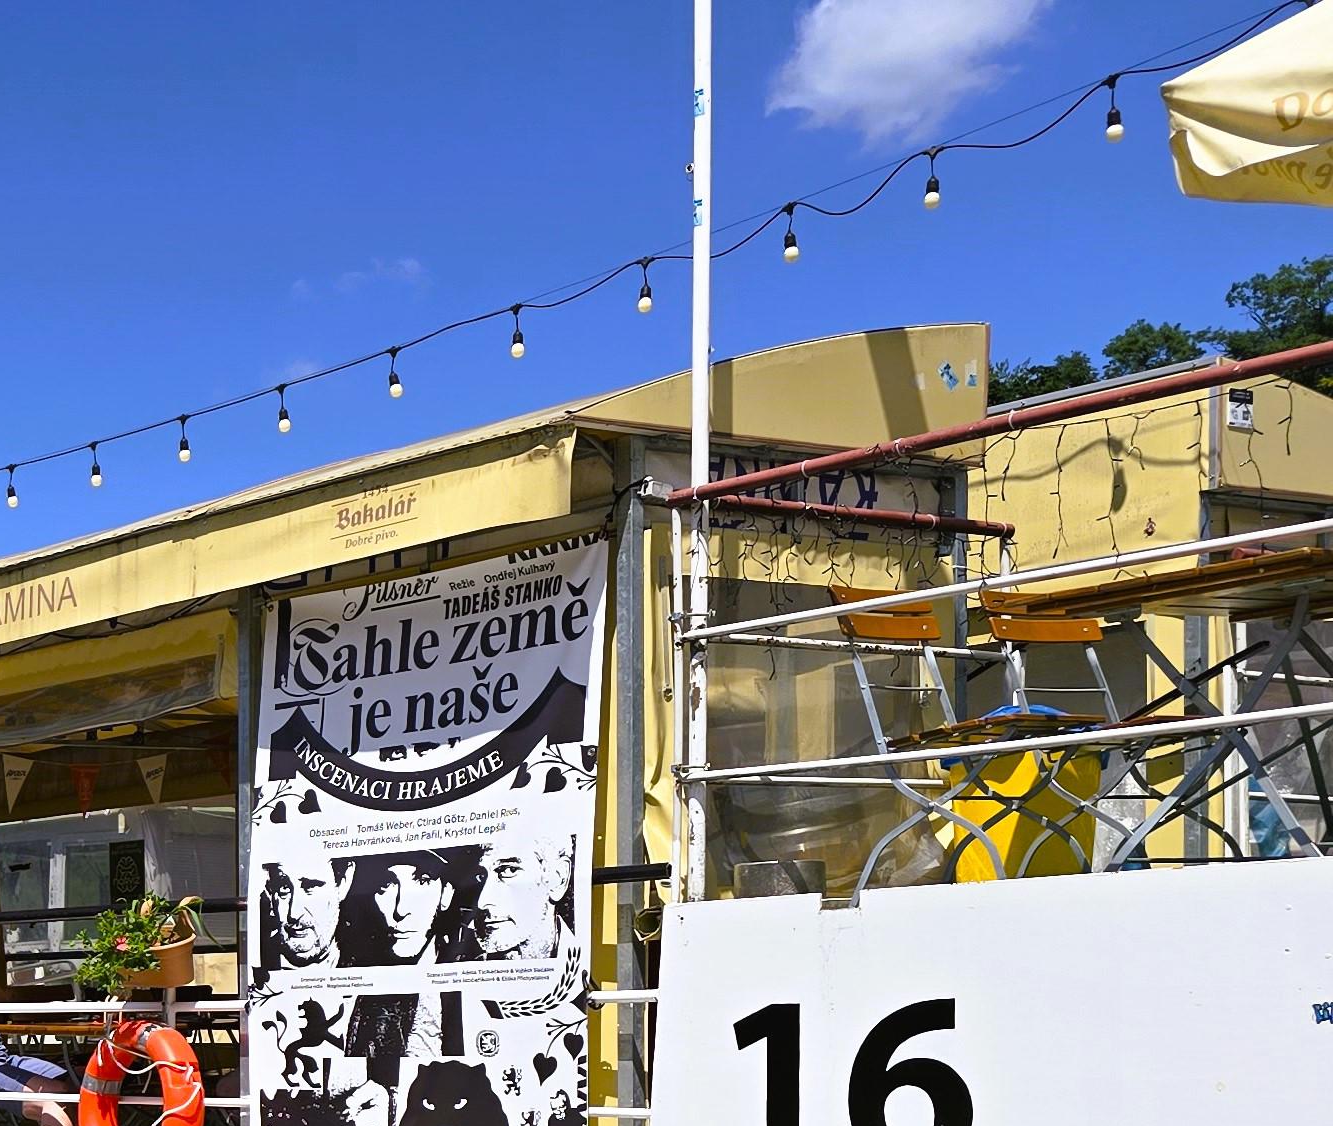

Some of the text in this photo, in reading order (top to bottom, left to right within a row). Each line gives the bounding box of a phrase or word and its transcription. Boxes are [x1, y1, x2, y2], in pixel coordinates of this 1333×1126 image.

[335, 491, 417, 530] Bakalář
[345, 530, 399, 549] Dobré pivo.
[449, 560, 557, 591] Režie Ondřej Kulhavý
[443, 574, 563, 620] TADEÁŠ STANKO
[280, 577, 591, 697] Tahle země
[340, 662, 519, 758] je naše
[293, 736, 504, 801] INSCENACI HRAJEME
[386, 820, 415, 832] Weber,
[469, 809, 499, 822] Daniel
[405, 832, 420, 842] Jan
